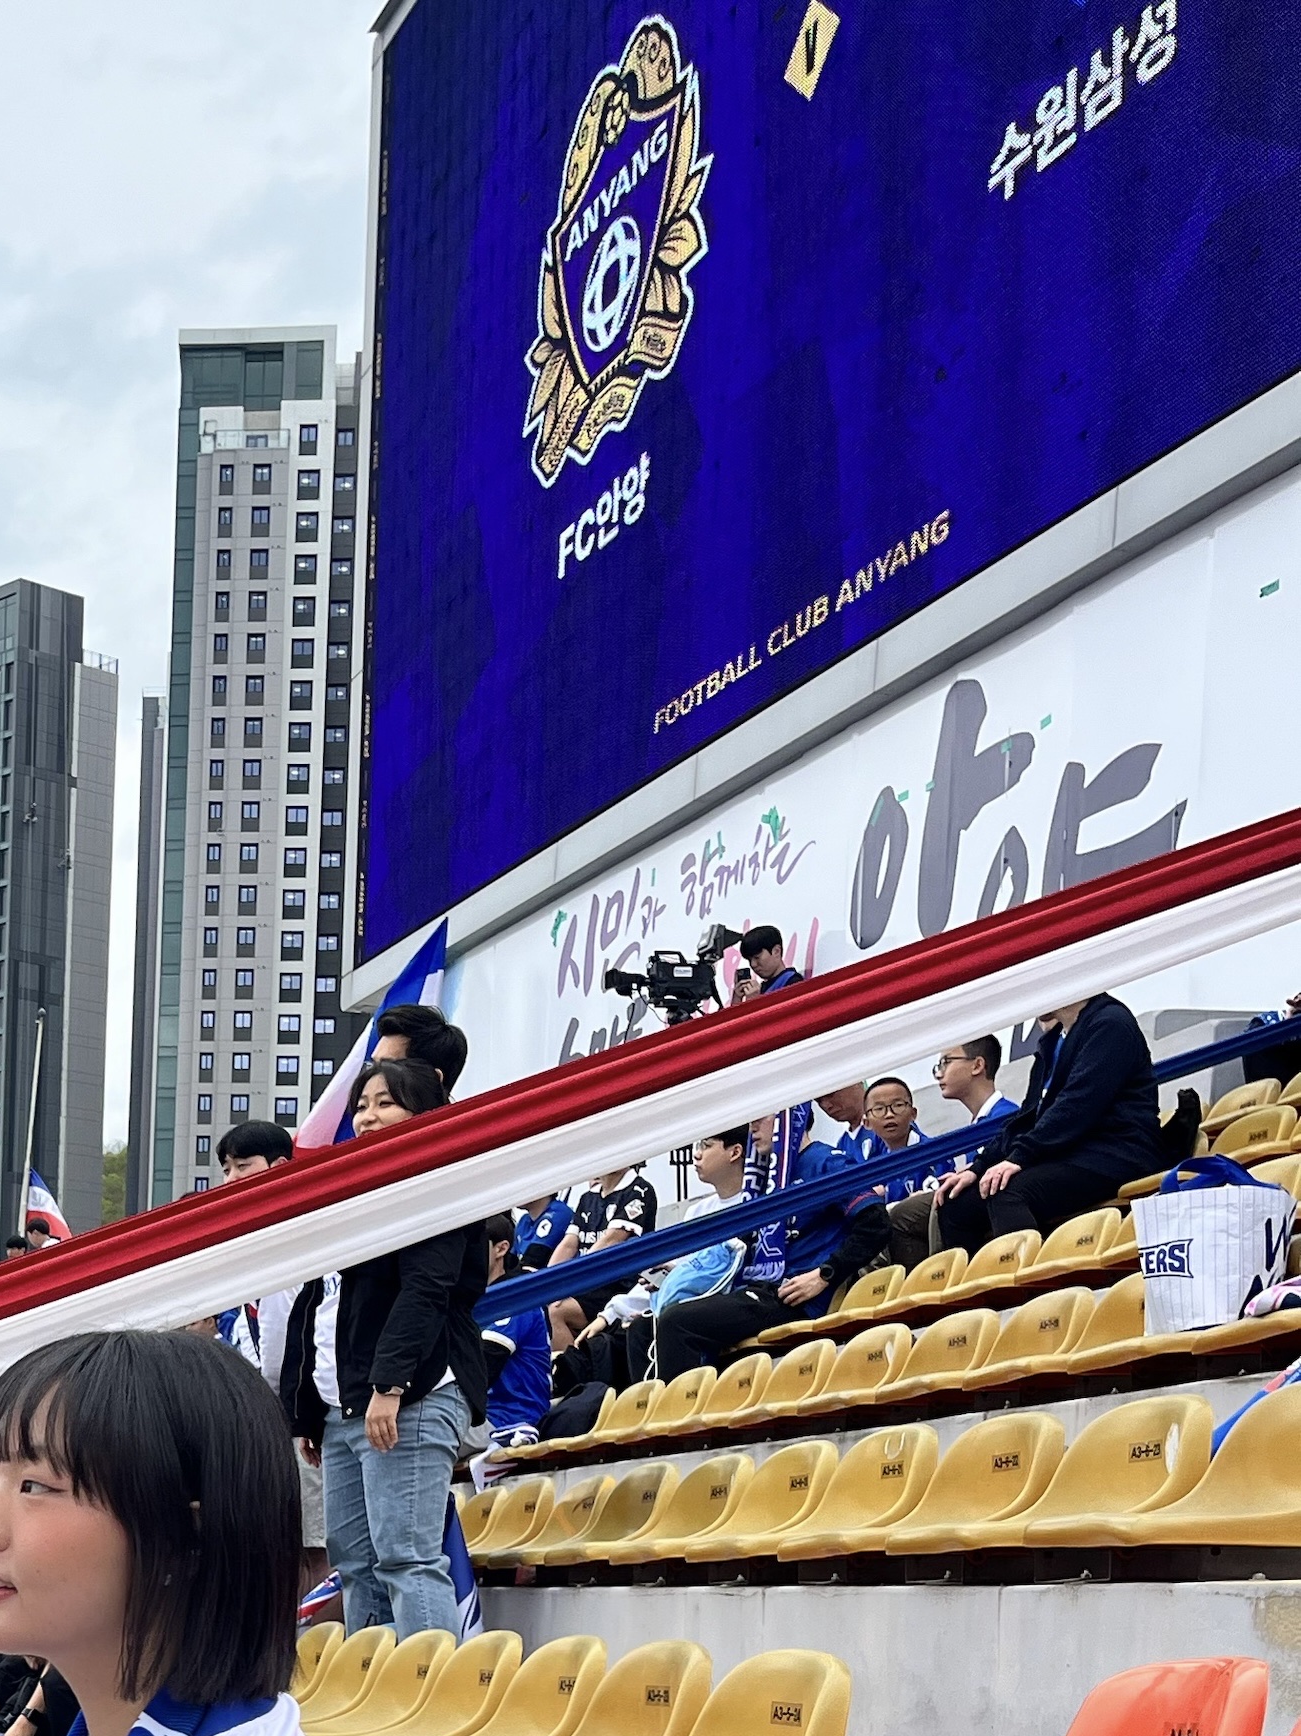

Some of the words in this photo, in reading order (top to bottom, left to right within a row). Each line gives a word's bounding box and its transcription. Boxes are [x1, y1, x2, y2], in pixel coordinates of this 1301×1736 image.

[988, 0, 1179, 200] 수원삼성
[564, 120, 668, 262] ANYANG
[557, 451, 651, 580] FC안양
[652, 643, 763, 735] FOOTBALL
[766, 595, 830, 657] CLUB
[834, 508, 951, 613] ANYANG
[1130, 1443, 1161, 1458] A3-6-23
